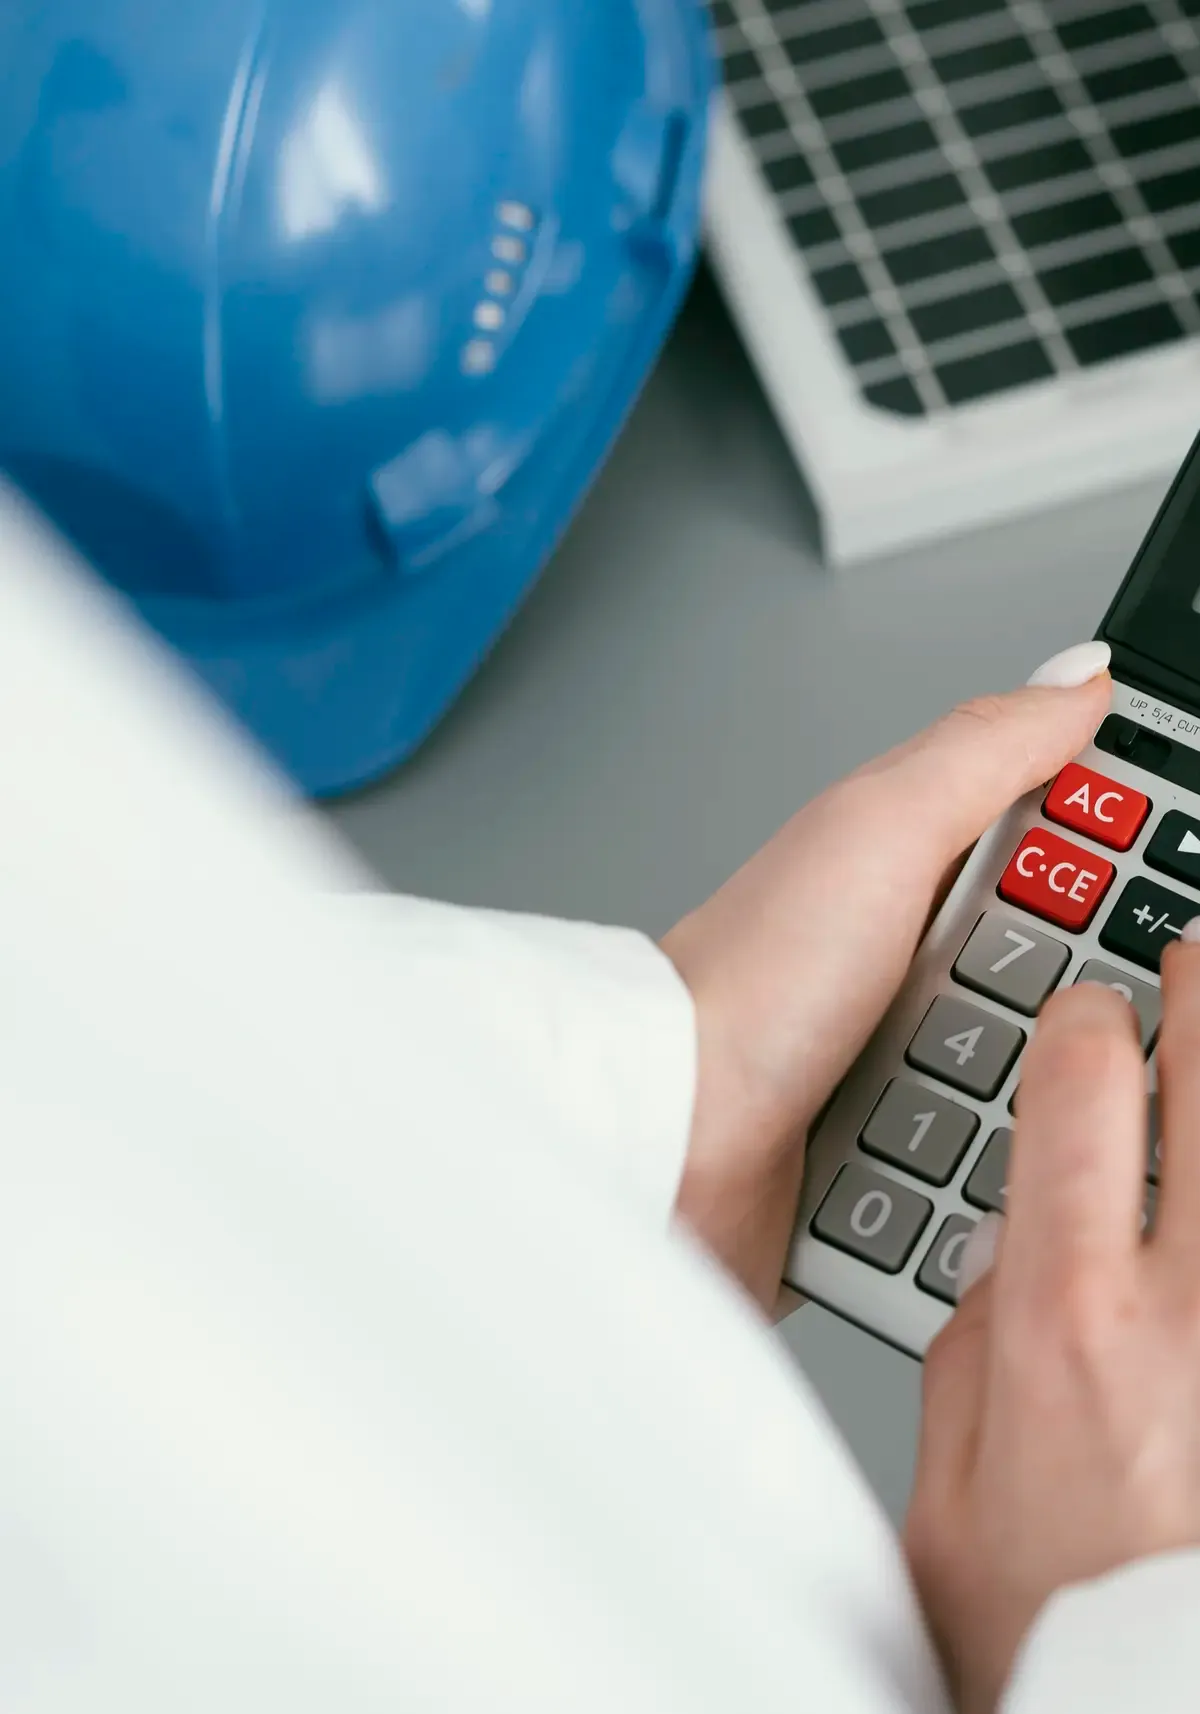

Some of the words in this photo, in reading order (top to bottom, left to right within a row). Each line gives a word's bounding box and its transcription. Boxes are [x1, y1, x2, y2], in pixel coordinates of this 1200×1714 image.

[1129, 697, 1148, 711] UP
[1151, 707, 1174, 724] 5/4
[1063, 782, 1124, 823] AC
[988, 928, 1036, 974] 7
[943, 1025, 985, 1066] 4
[907, 1110, 937, 1152] 1
[849, 1189, 893, 1238] 0
